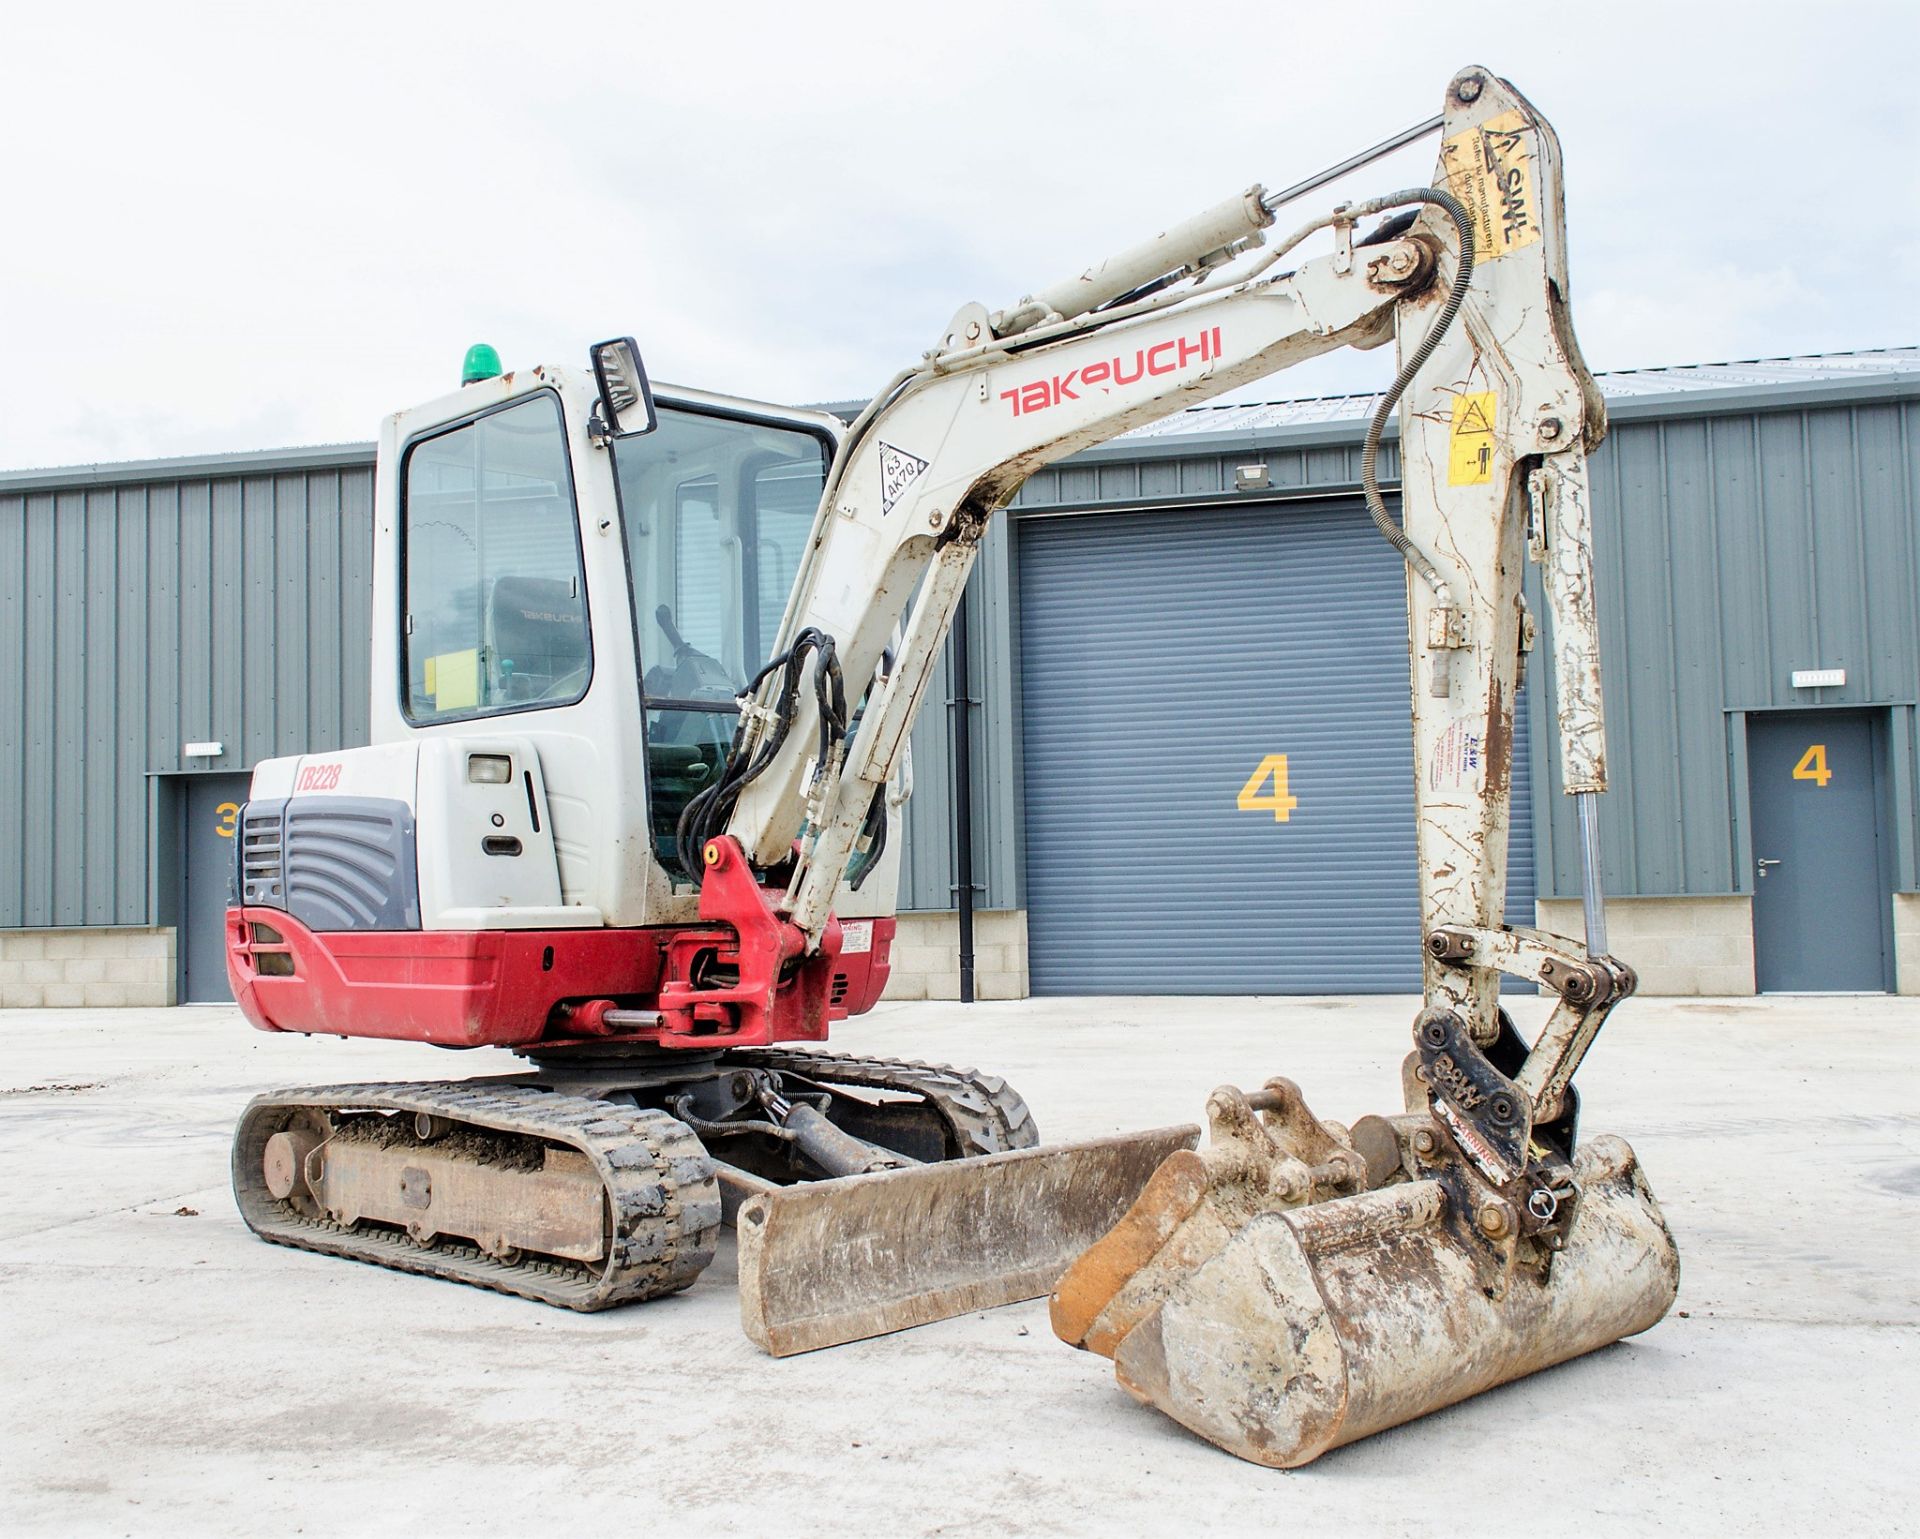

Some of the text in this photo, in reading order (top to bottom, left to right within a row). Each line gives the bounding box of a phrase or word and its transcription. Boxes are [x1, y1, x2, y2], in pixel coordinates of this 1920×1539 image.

[1463, 173, 1473, 201] duty
[1477, 175, 1494, 249] manufacturers
[1497, 168, 1527, 245] SWL
[887, 455, 901, 476] 63
[888, 462, 915, 498] AK7Q
[297, 764, 343, 791] TB228
[1792, 744, 1833, 787] 4
[1237, 754, 1298, 823] 4
[215, 802, 238, 838] 3
